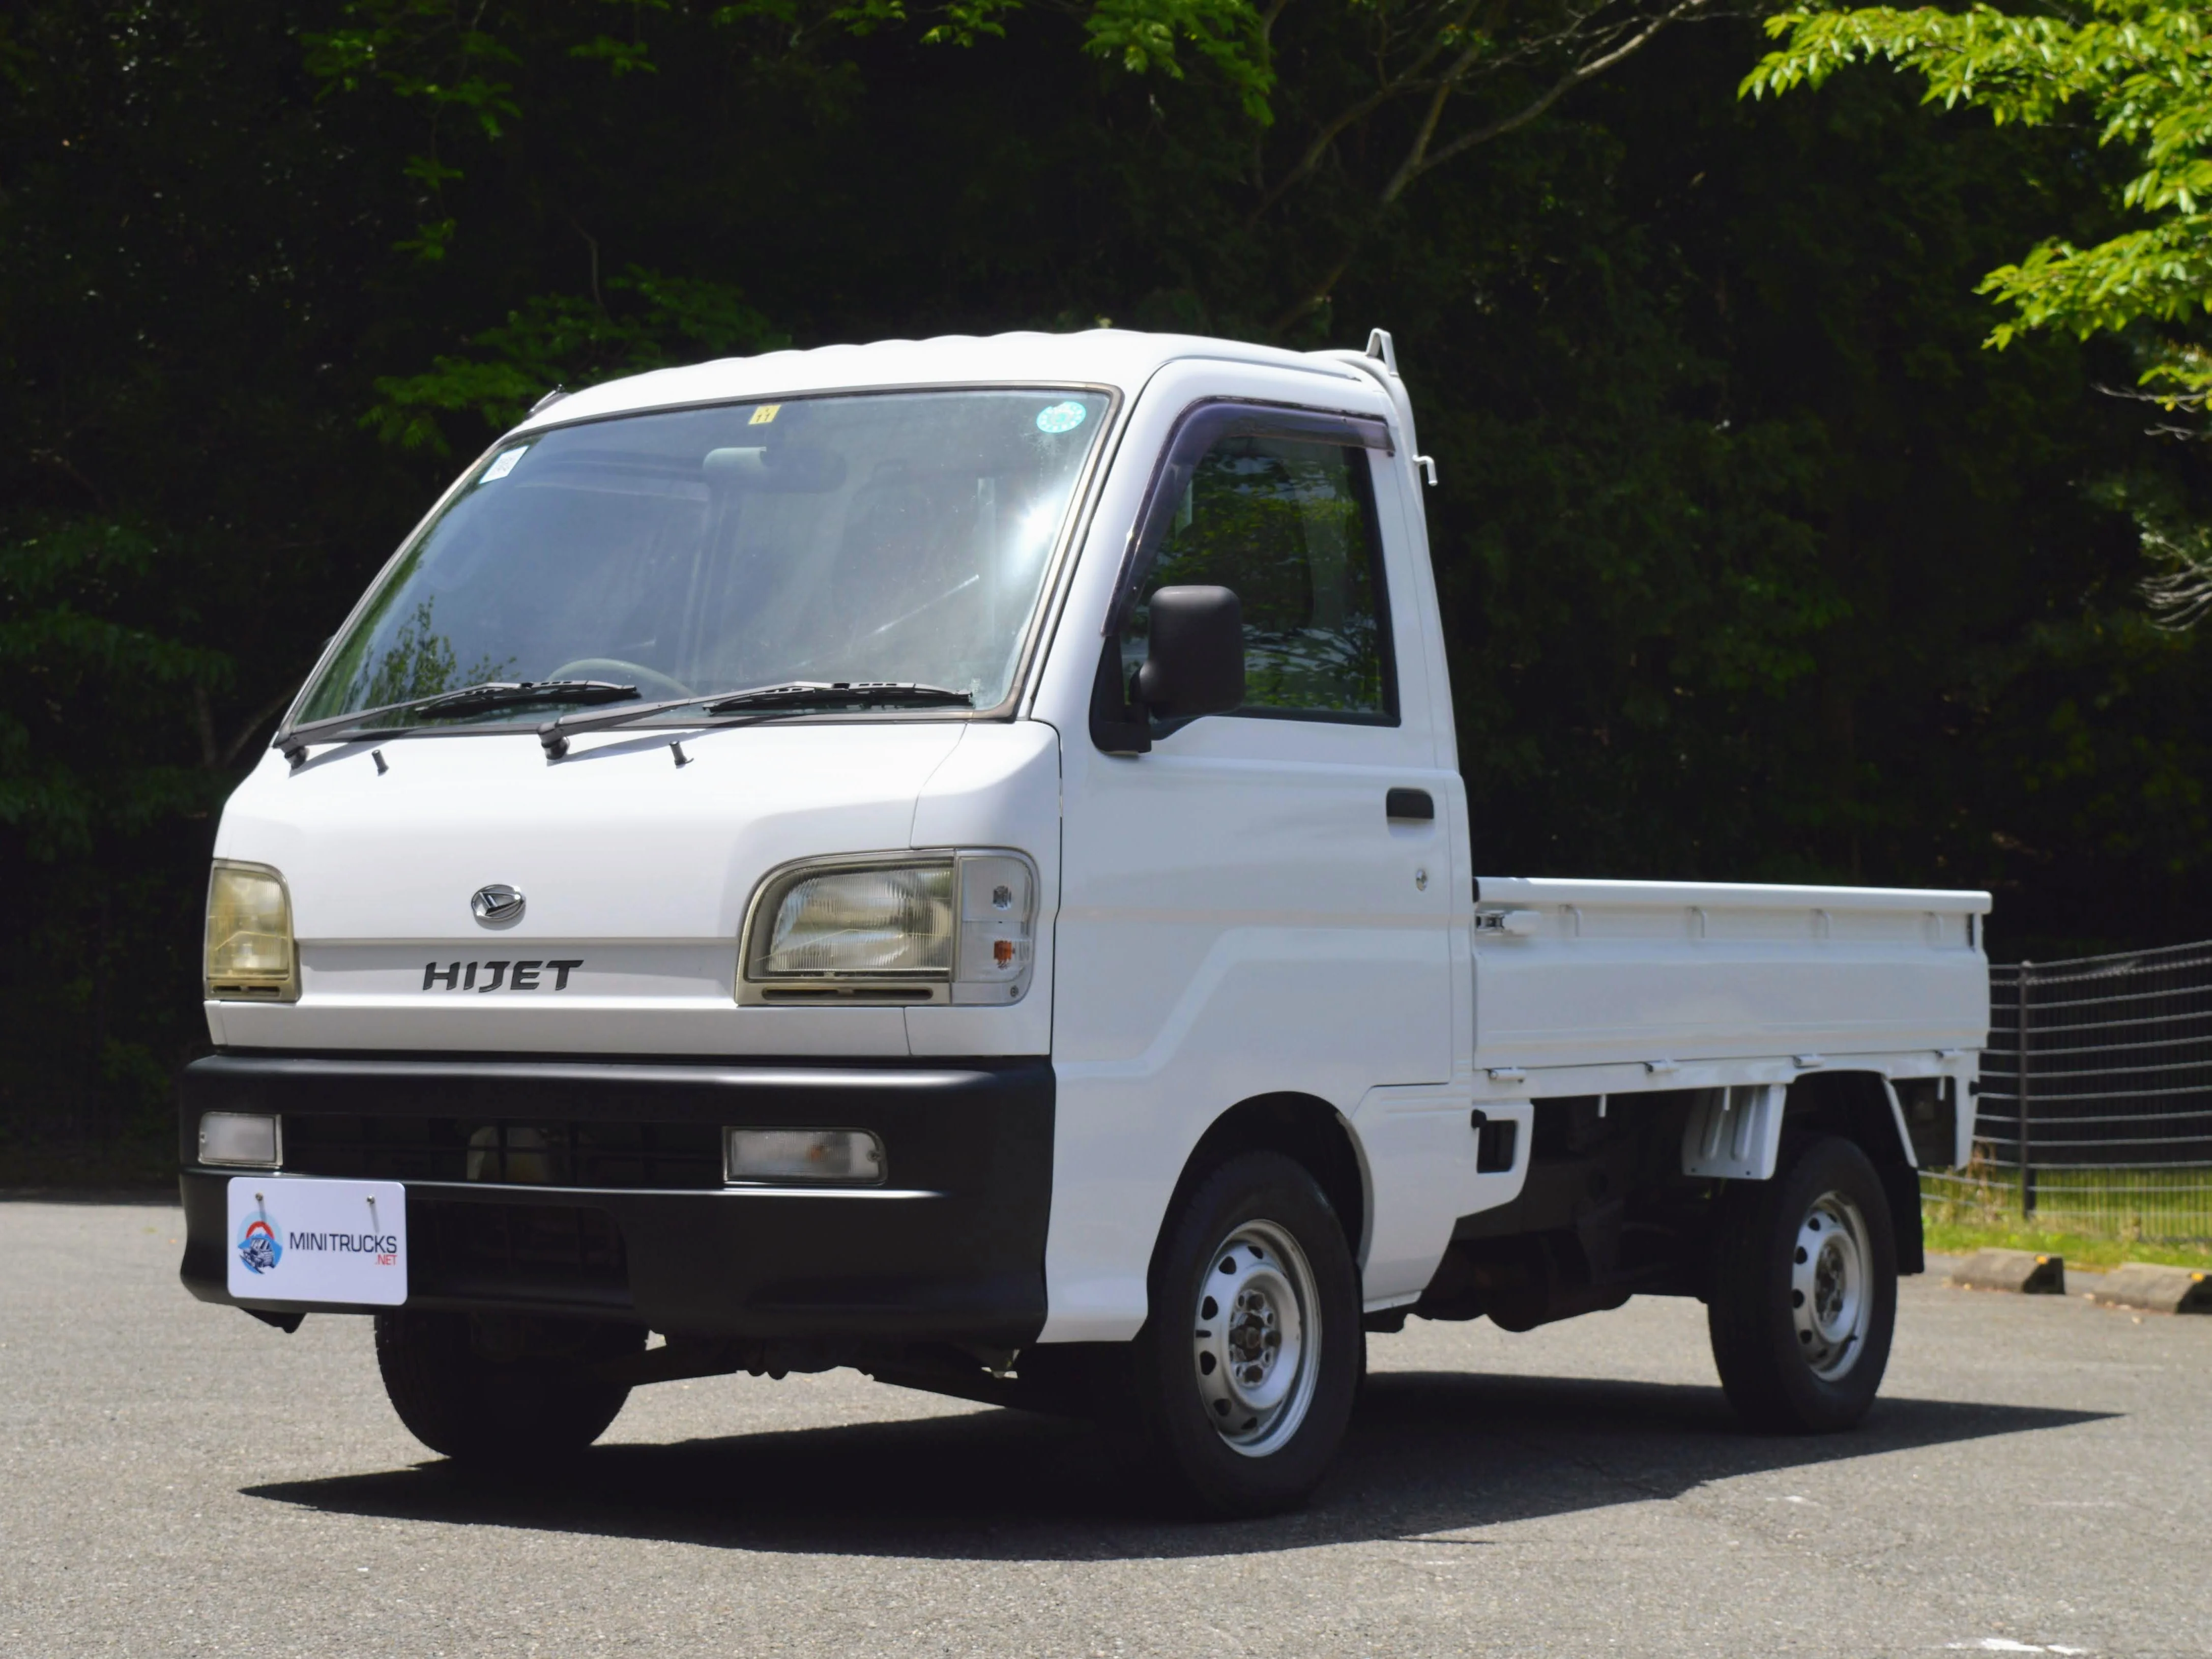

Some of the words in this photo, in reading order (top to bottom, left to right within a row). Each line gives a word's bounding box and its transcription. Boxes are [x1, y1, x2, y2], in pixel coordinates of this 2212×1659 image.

[423, 960, 584, 993] HIJET
[290, 1232, 397, 1254] MINITRUCKS
[375, 1255, 397, 1266] .NET
